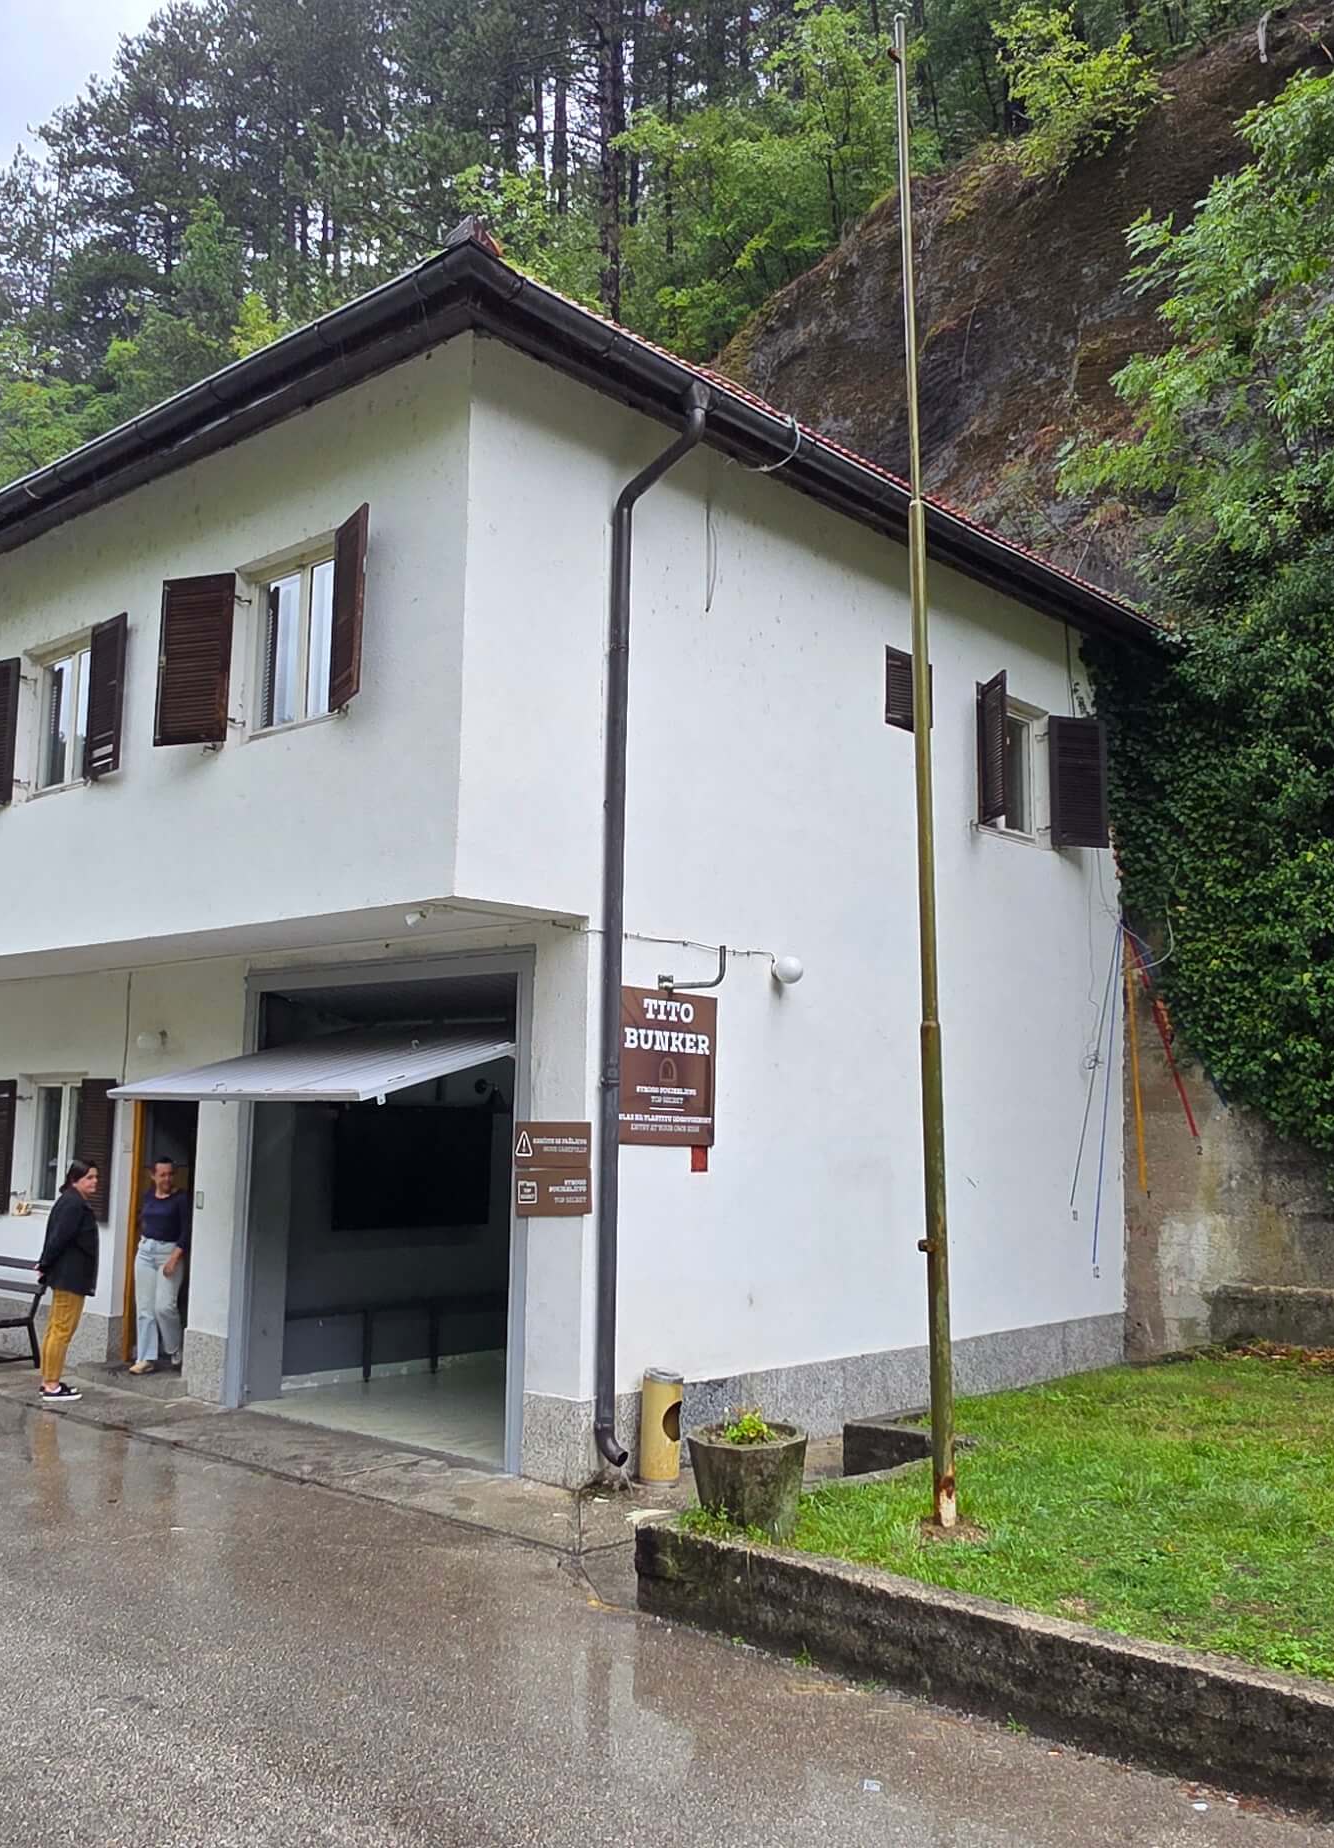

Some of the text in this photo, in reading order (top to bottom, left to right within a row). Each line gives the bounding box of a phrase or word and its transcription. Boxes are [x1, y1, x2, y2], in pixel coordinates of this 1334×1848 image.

[643, 998, 694, 1024] TITO
[624, 1027, 710, 1056] BUNKER
[1196, 1145, 1203, 1155] 2
